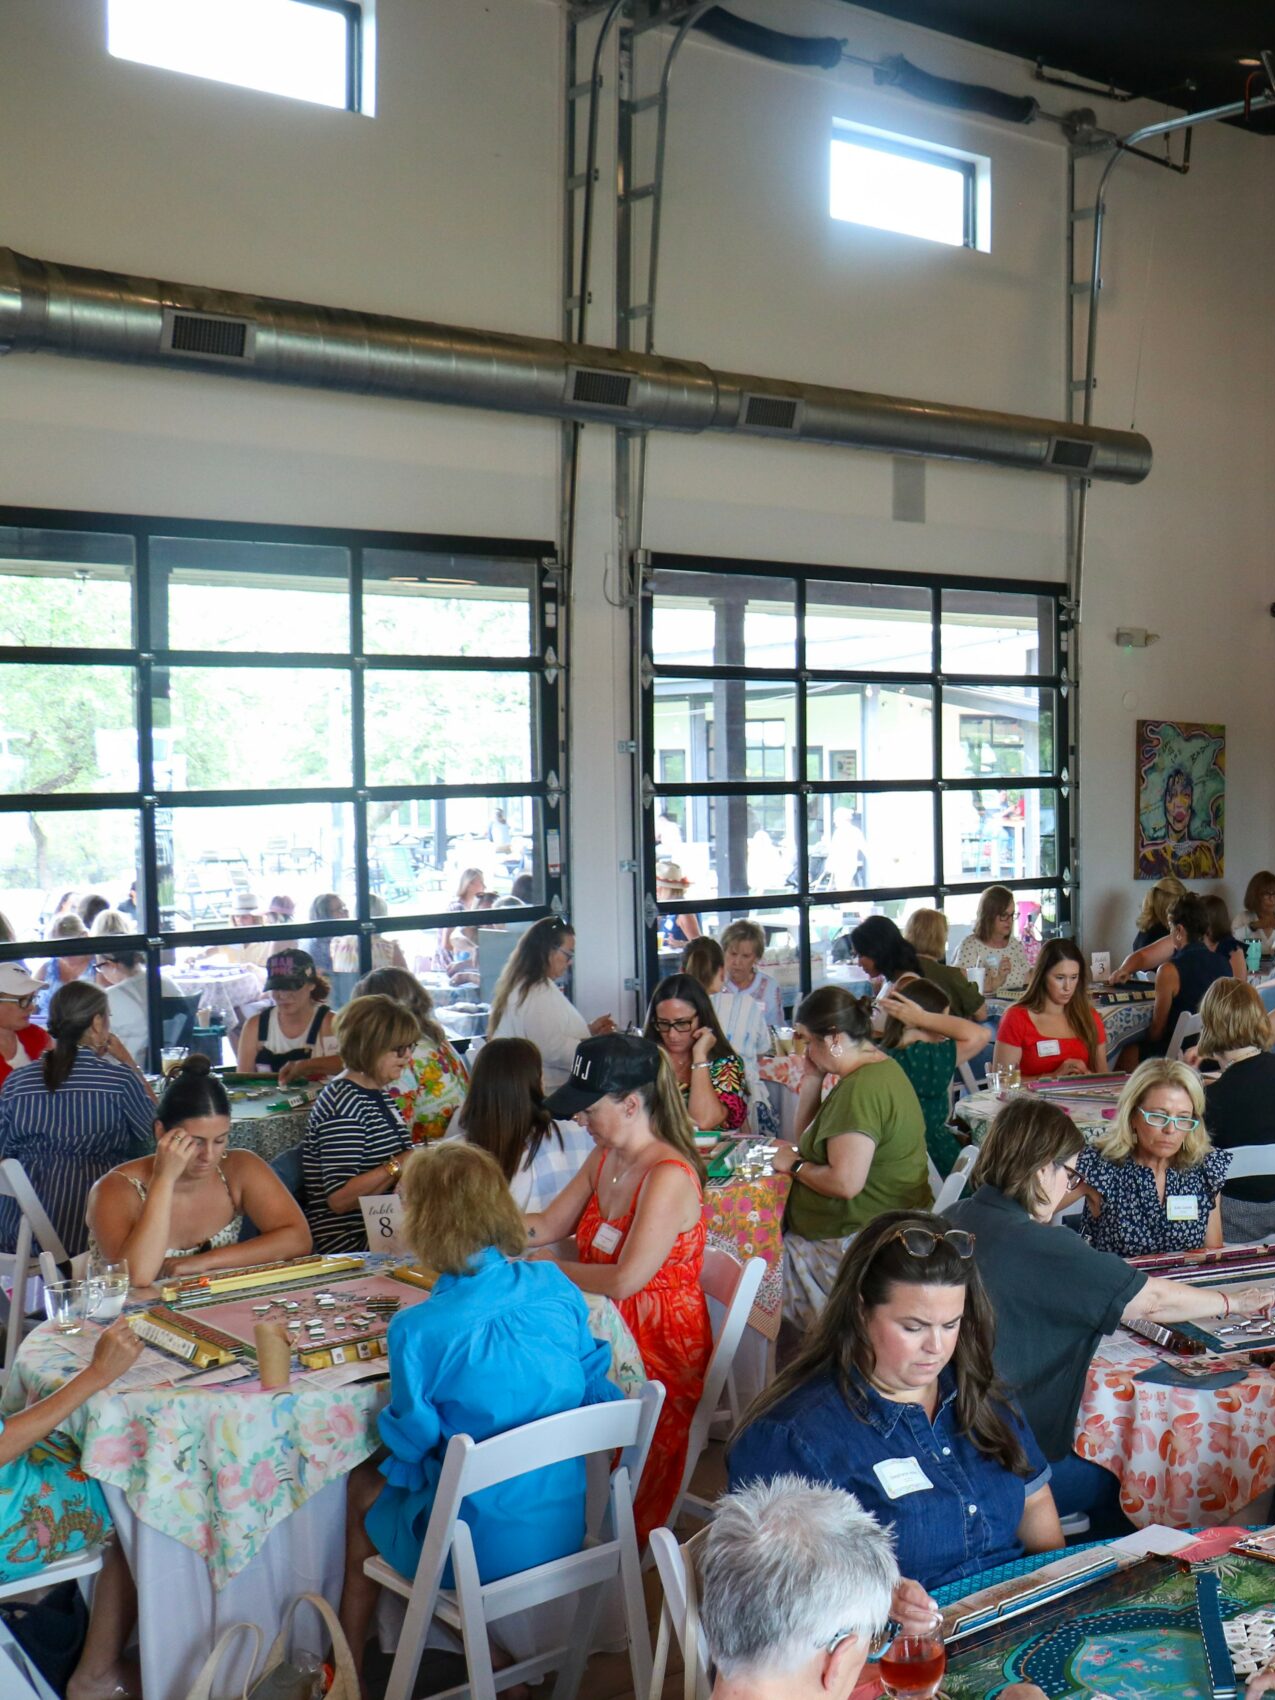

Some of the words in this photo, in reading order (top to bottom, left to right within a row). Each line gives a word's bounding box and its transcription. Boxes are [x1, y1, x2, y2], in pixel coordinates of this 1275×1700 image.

[1098, 963, 1105, 975] 3
[571, 1055, 592, 1081] HJ
[368, 1203, 395, 1216] table
[379, 1216, 394, 1238] 8
